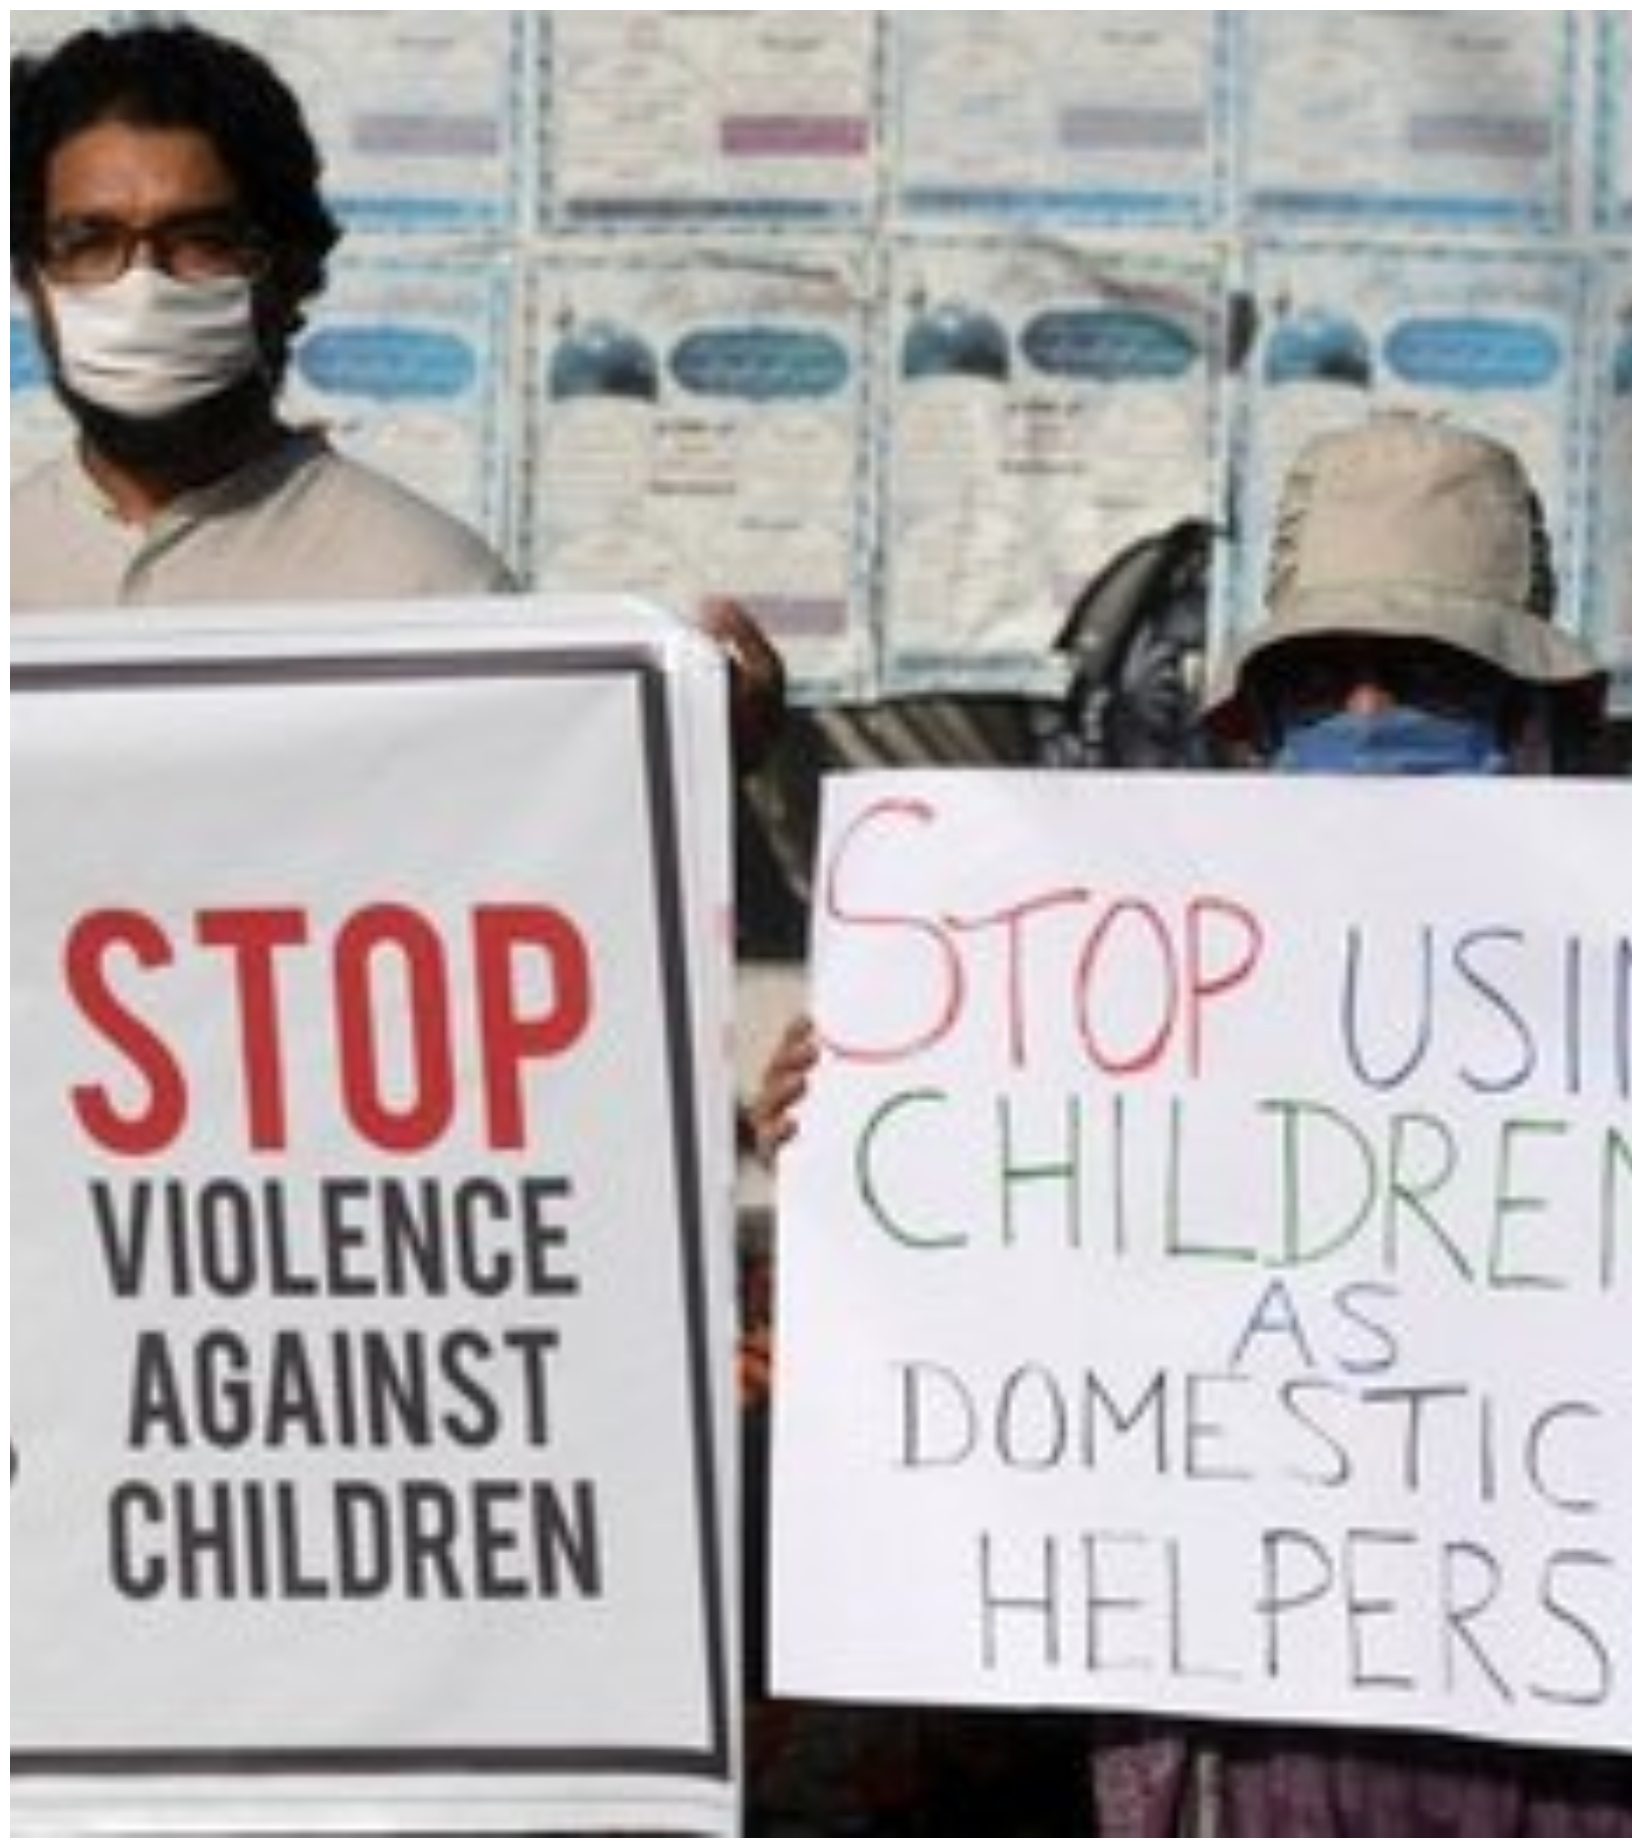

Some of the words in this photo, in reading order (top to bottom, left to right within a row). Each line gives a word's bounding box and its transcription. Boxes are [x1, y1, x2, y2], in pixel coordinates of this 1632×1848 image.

[819, 800, 1263, 1078] STOP
[62, 903, 593, 1158] STOP
[89, 1177, 580, 1298] VIOLENCE
[129, 1329, 560, 1450] AGAINST
[1229, 1280, 1399, 1376] AS
[894, 1361, 1604, 1515] DOMESTIC
[109, 1480, 602, 1600] CHILDREN
[977, 1527, 1616, 1706] HELPERS
